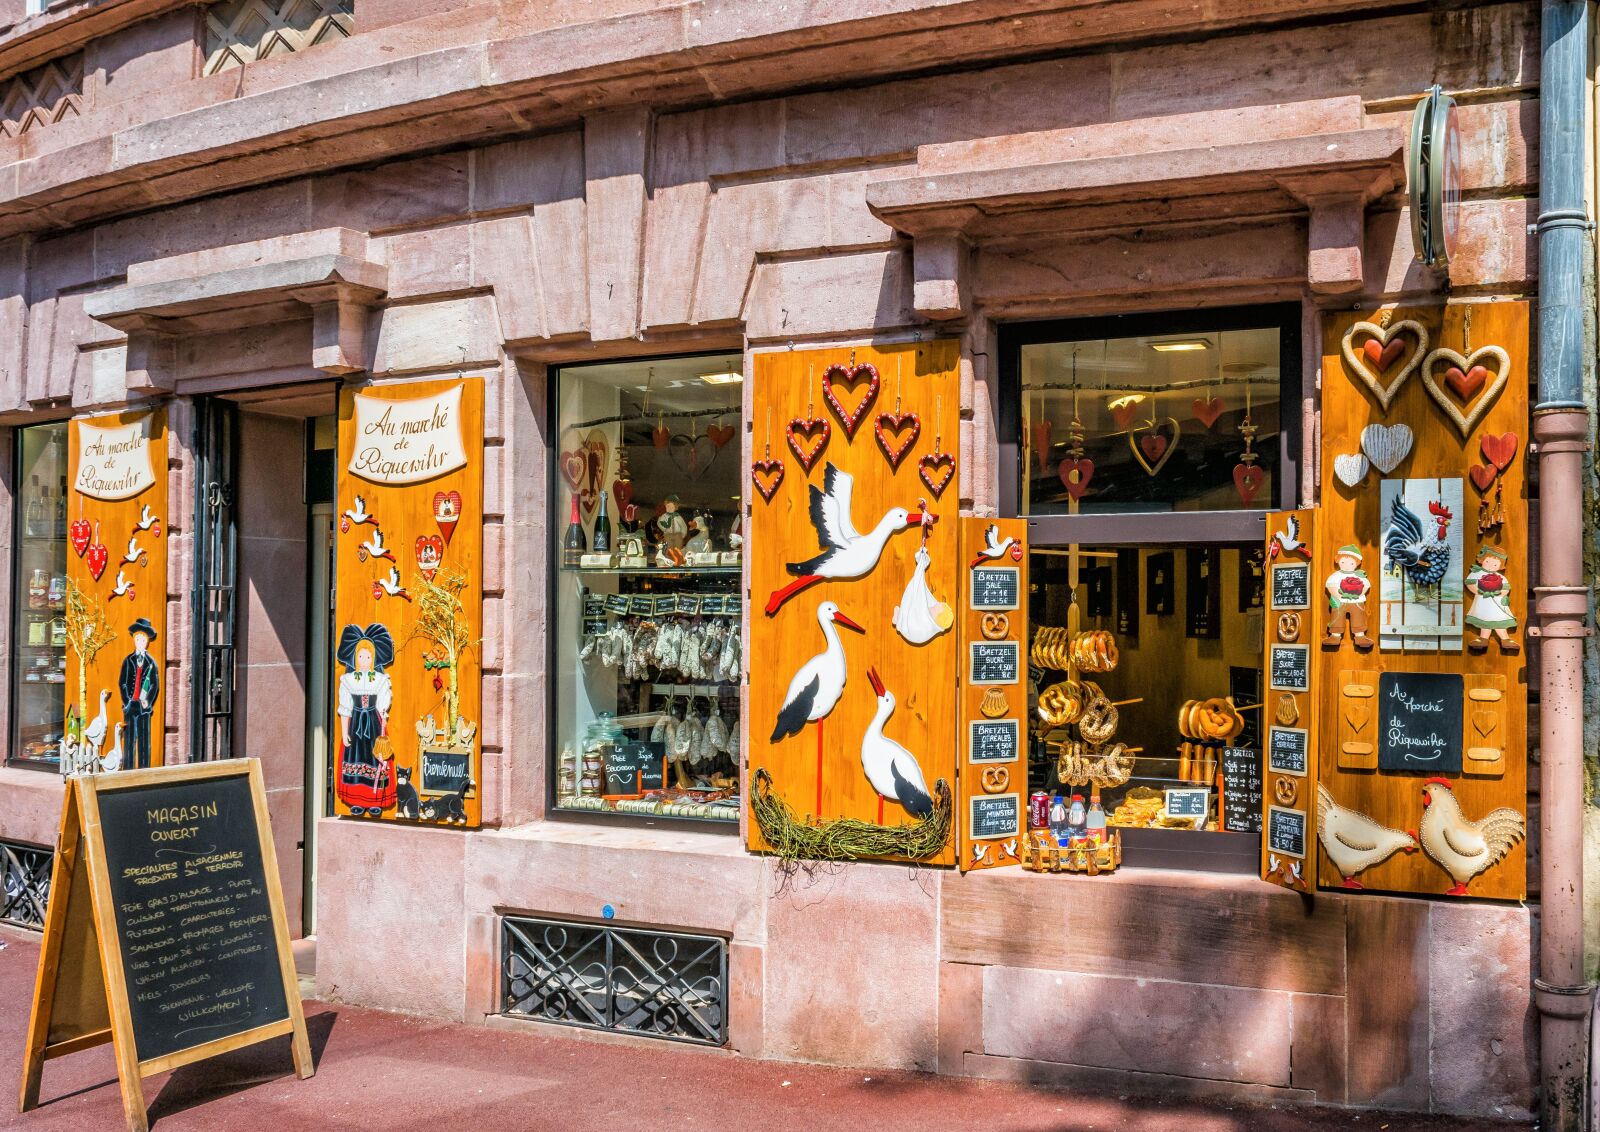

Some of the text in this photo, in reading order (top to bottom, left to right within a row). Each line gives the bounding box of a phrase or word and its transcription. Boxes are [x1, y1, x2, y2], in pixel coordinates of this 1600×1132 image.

[364, 403, 449, 436] Au marché
[85, 434, 105, 456] Au
[394, 437, 410, 450] de
[104, 456, 116, 469] de
[355, 443, 448, 480] Riquewihr
[80, 465, 141, 496] Riquewihr
[1390, 682, 1406, 701] Au
[1390, 715, 1405, 728] de
[1388, 727, 1447, 749] Riquewihr
[148, 801, 218, 824] MAGASIN
[151, 826, 199, 842] OUVERT
[185, 851, 243, 868] ALSACIENNES
[134, 872, 178, 886] PRODUITS
